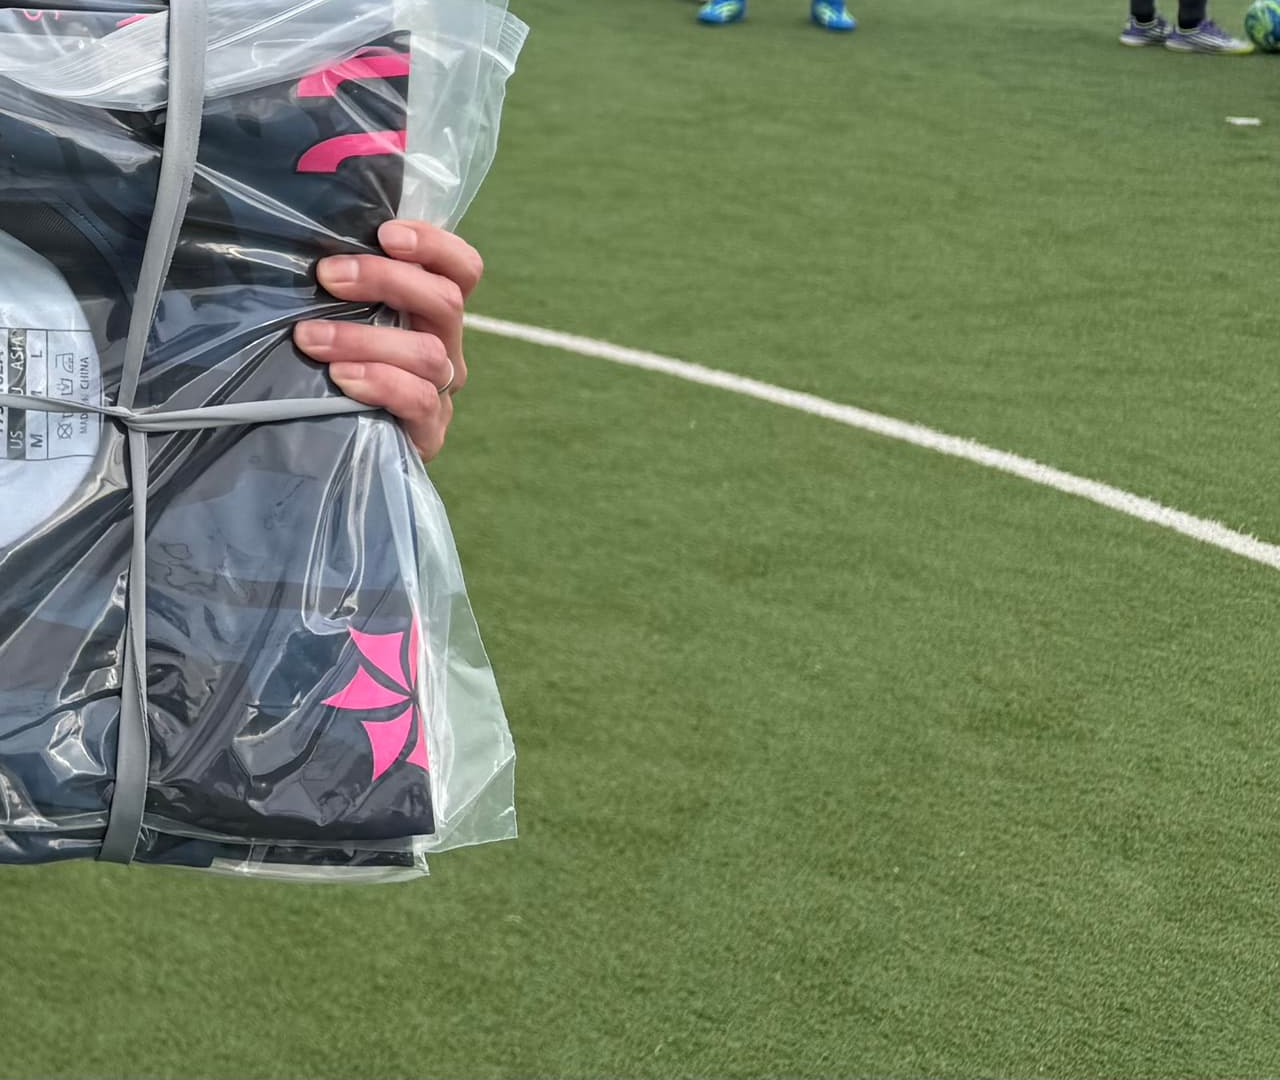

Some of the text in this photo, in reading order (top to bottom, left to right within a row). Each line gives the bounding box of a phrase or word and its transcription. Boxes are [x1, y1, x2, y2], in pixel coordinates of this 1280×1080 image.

[10, 335, 25, 371] ASIA
[80, 357, 88, 389] CHINA
[30, 350, 43, 448] M L
[80, 411, 88, 434] MAD
[10, 430, 23, 449] US
